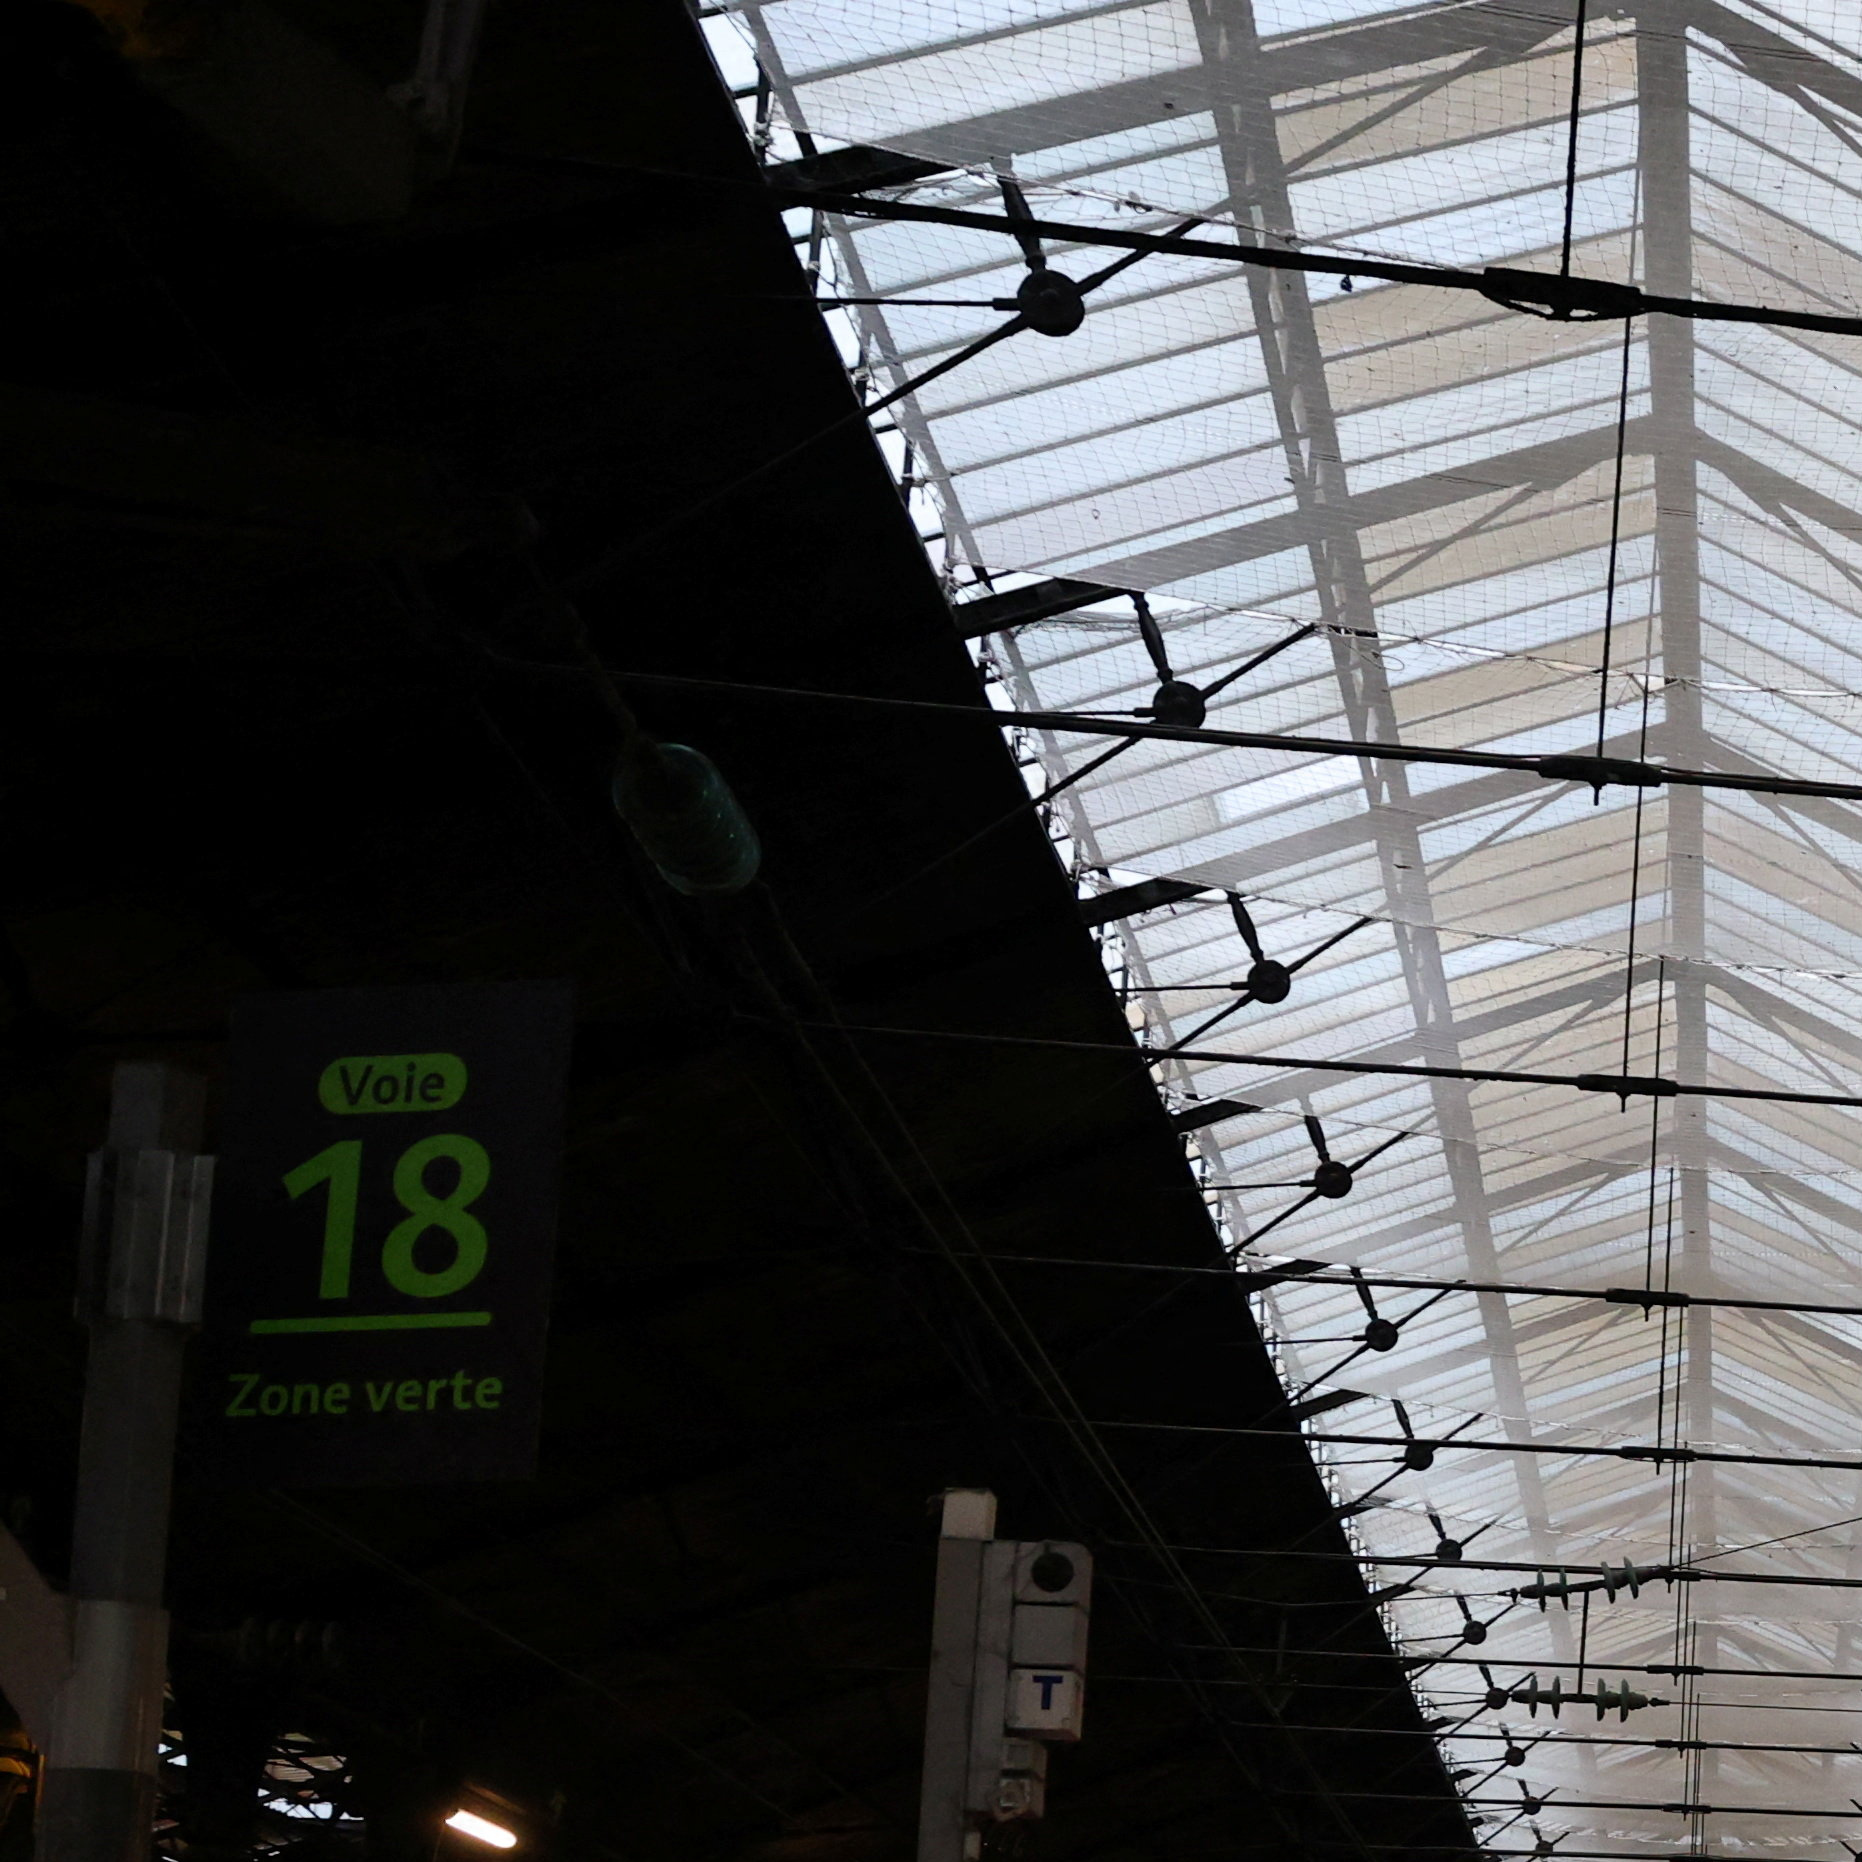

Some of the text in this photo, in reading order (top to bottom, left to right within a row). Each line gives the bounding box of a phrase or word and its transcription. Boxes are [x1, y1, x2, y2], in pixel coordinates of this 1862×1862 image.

[339, 1061, 446, 1106] Voie
[281, 1132, 493, 1300] 18
[224, 1369, 505, 1417] Zone verte
[1033, 1675, 1064, 1710] T
